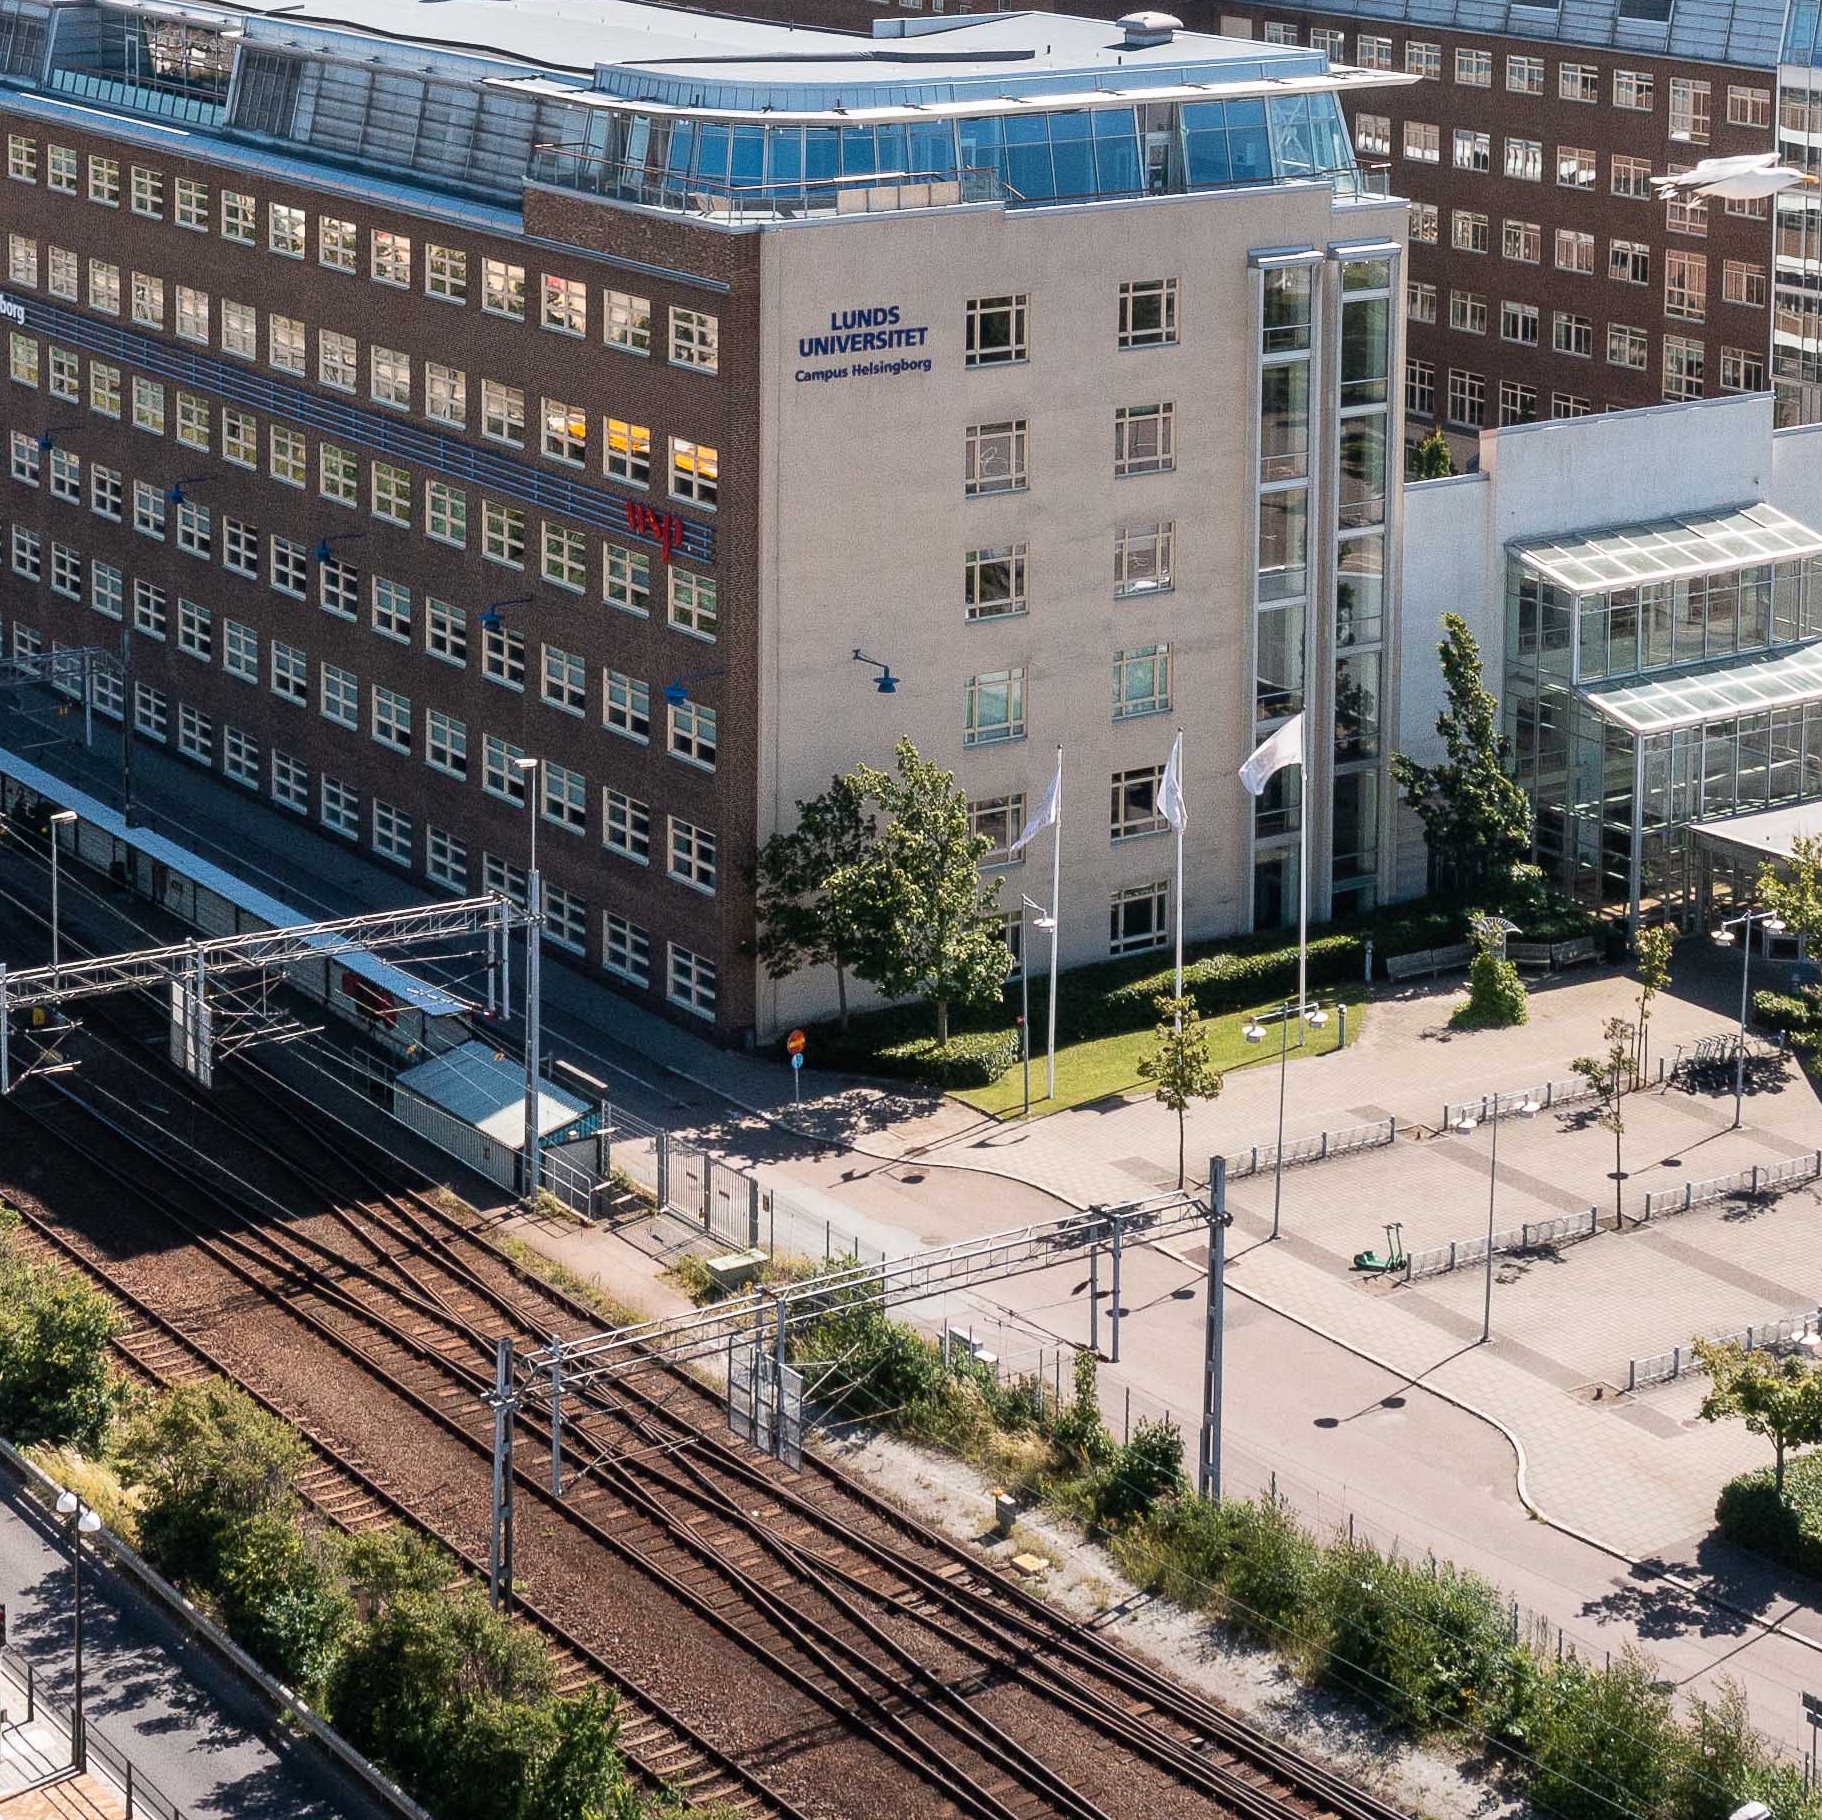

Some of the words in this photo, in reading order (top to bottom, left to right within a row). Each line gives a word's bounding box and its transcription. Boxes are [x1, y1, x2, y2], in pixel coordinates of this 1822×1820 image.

[831, 305, 900, 331] LUNDS
[799, 327, 928, 357] UNIVERSITET
[795, 367, 849, 383] Campus
[852, 358, 932, 378] Helsingborg
